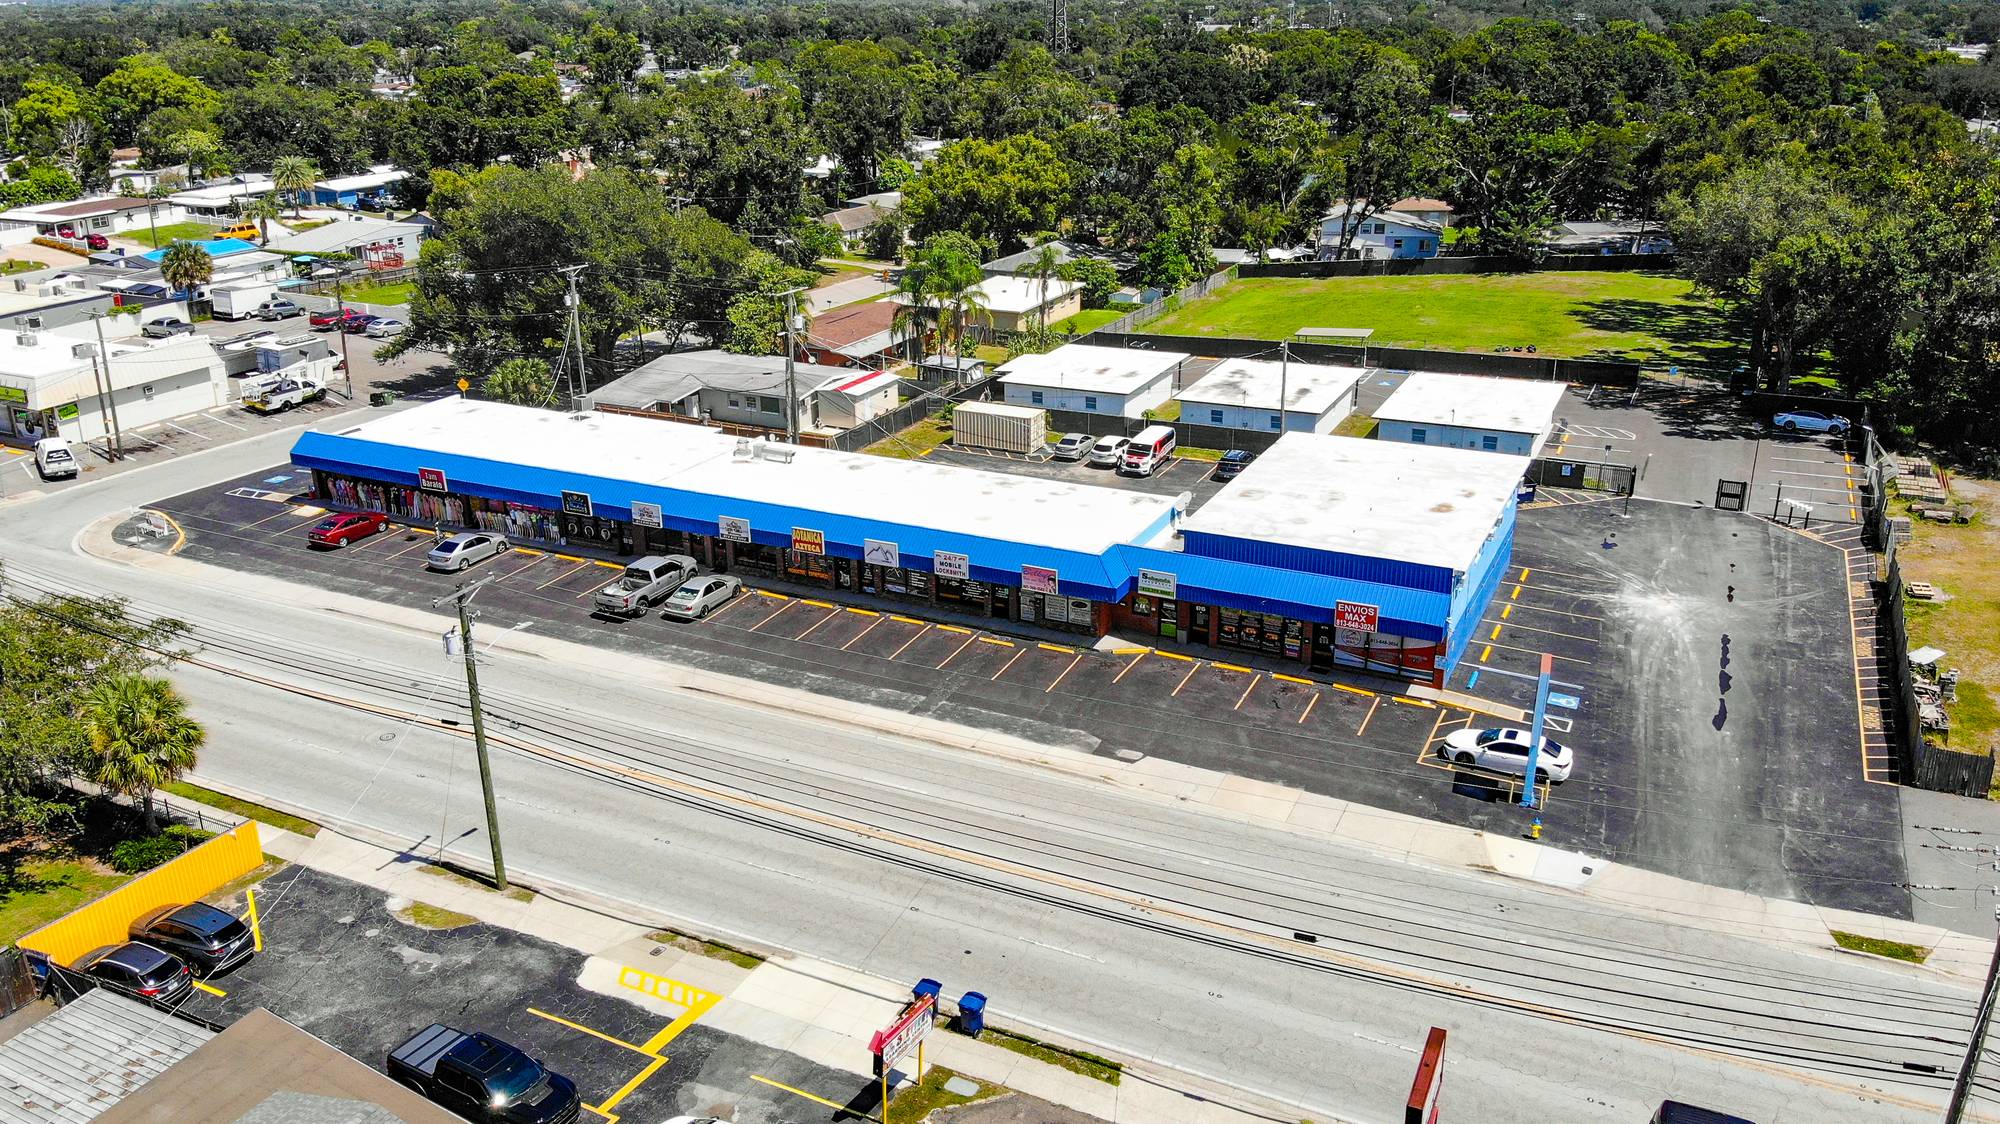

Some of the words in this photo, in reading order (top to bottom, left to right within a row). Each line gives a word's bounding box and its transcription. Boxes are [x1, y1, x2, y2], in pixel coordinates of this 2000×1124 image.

[422, 478, 443, 489] Barato
[795, 542, 821, 553] AZTECA
[939, 560, 962, 569] MOBILE
[935, 567, 966, 577] LOCKSMITH
[1338, 603, 1375, 616] ENVIOS
[1344, 613, 1366, 623] MAX
[1336, 619, 1374, 631] 813-648-3024
